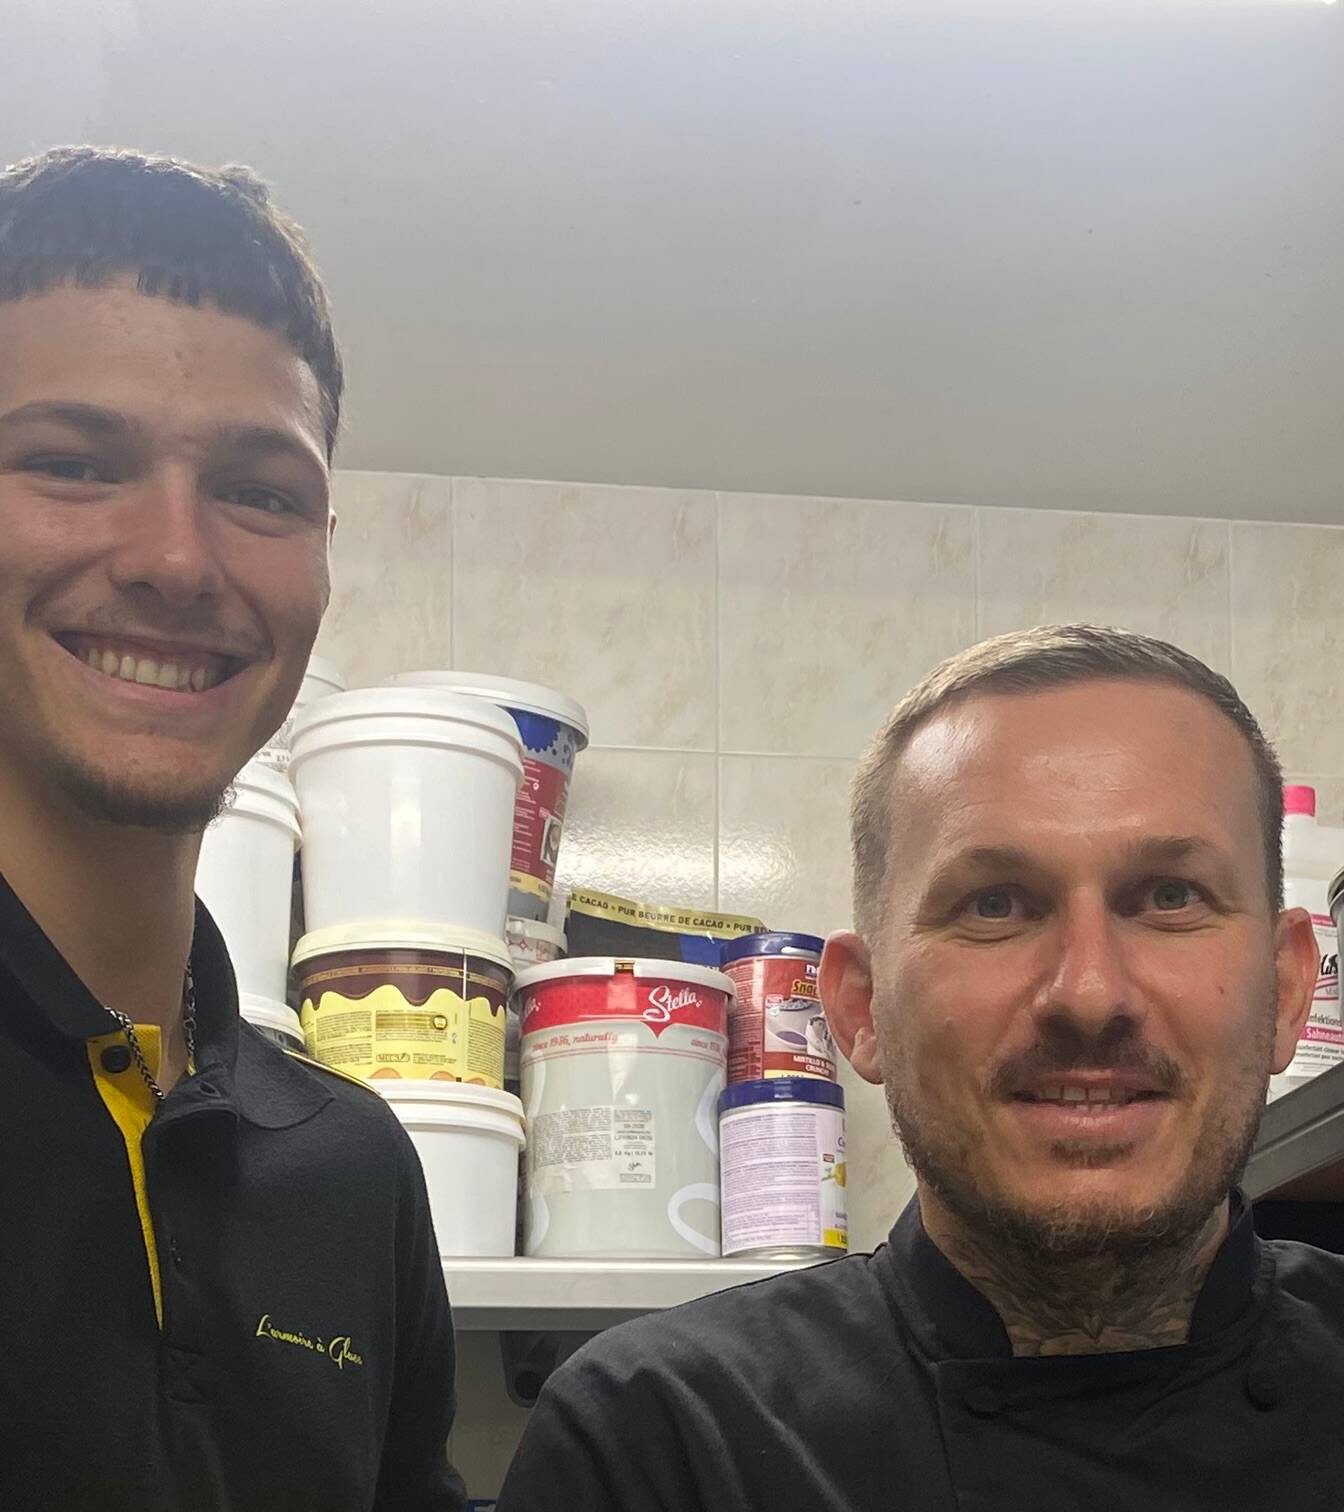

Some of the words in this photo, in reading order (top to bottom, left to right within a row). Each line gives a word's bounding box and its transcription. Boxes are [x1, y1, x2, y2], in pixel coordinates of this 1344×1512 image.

[579, 894, 609, 911] CACAO
[617, 905, 636, 918] PUR
[638, 910, 675, 924] BEURRE
[678, 916, 690, 926] DE
[692, 918, 724, 930] CACAO
[733, 922, 752, 933] PUR
[642, 985, 703, 1023] Stella
